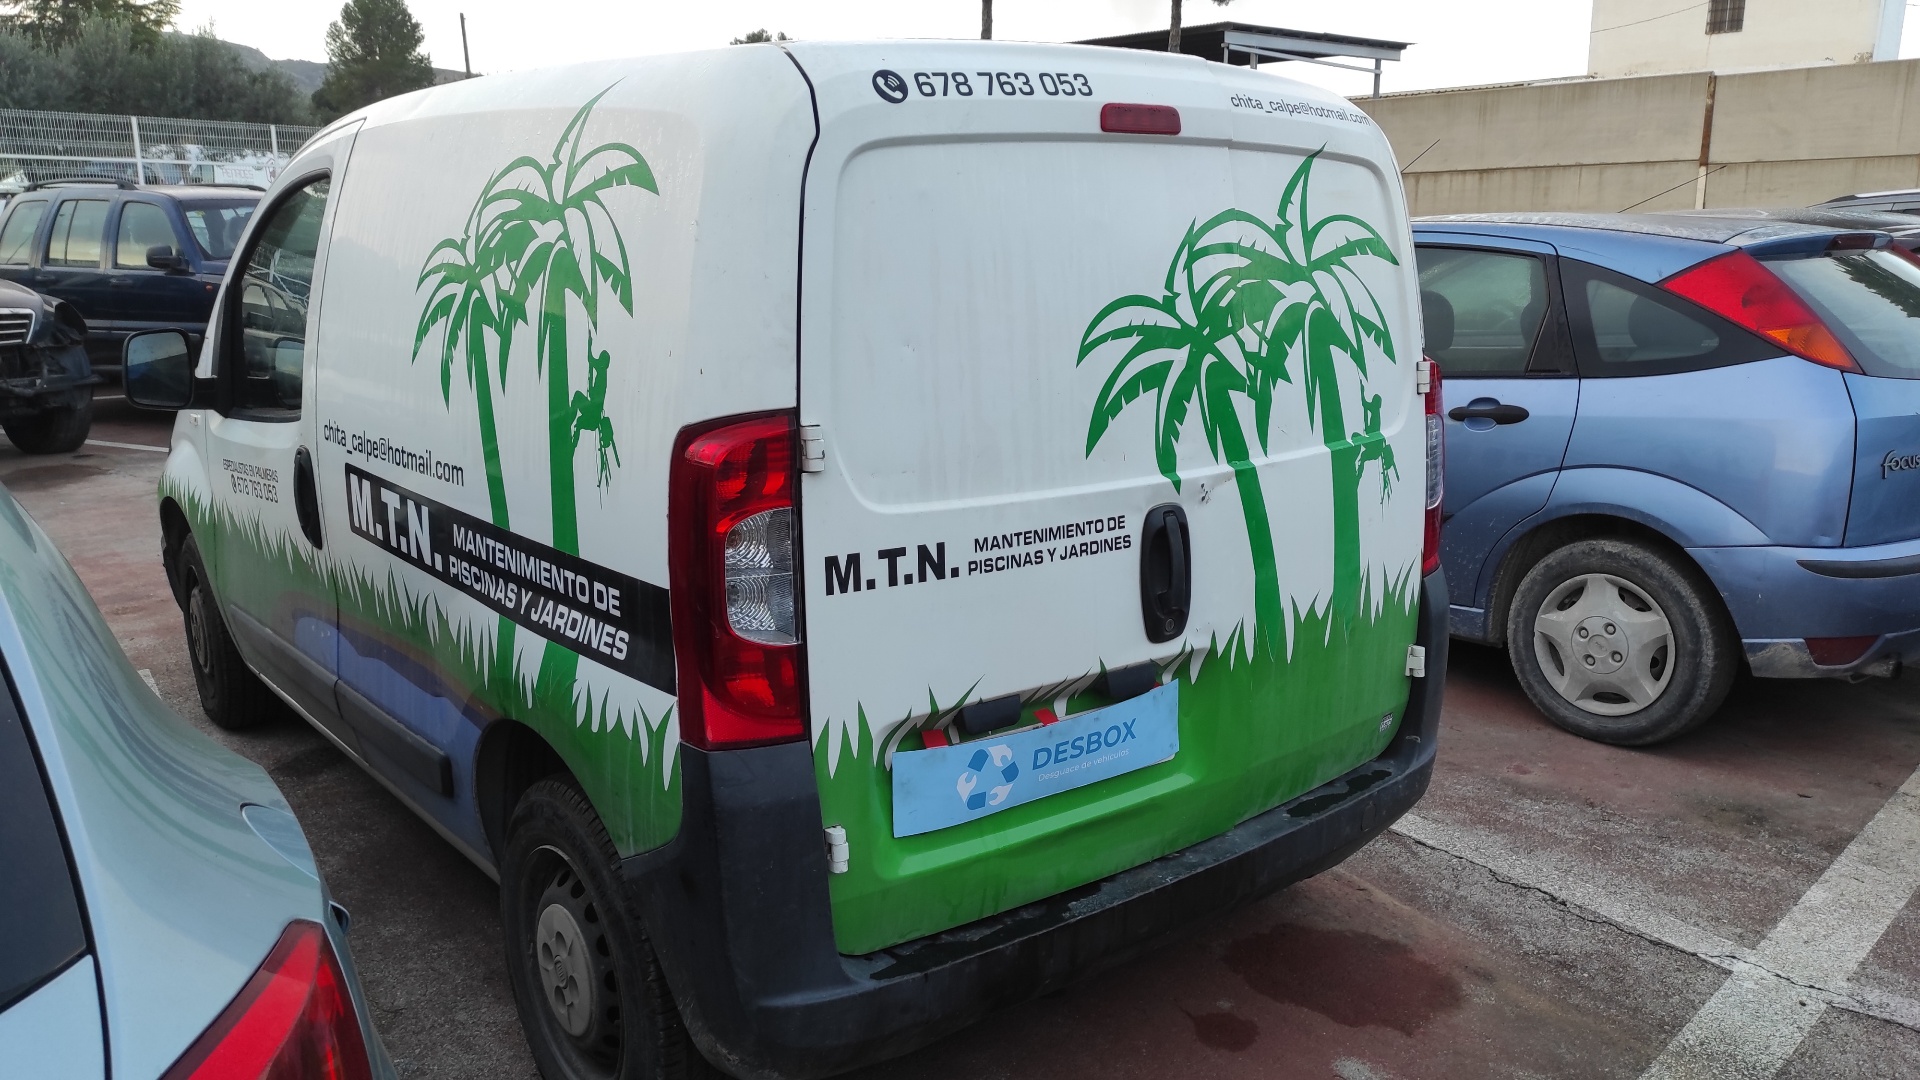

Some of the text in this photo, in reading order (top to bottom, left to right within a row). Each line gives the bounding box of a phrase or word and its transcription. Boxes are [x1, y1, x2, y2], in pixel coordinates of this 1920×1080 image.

[913, 71, 1093, 97] 678 763 053
[1230, 93, 1371, 126] chita_calpe@hotmail.com
[323, 418, 465, 488] chita_calpe@hotmail.com
[237, 475, 279, 503] 678 763 053
[349, 471, 444, 573] M.T.N.
[973, 514, 1127, 554] MANTENIMIENTO DE
[452, 522, 622, 619] MANTENIMIENTO DE
[824, 541, 961, 597] M.T.N.
[967, 534, 1132, 577] PISCINAS Y JARDINES
[448, 553, 630, 662] PISCINAS Y JARDINES
[1032, 717, 1138, 771] DESBOX
[1038, 764, 1081, 783] Desguace
[1080, 760, 1093, 770] de
